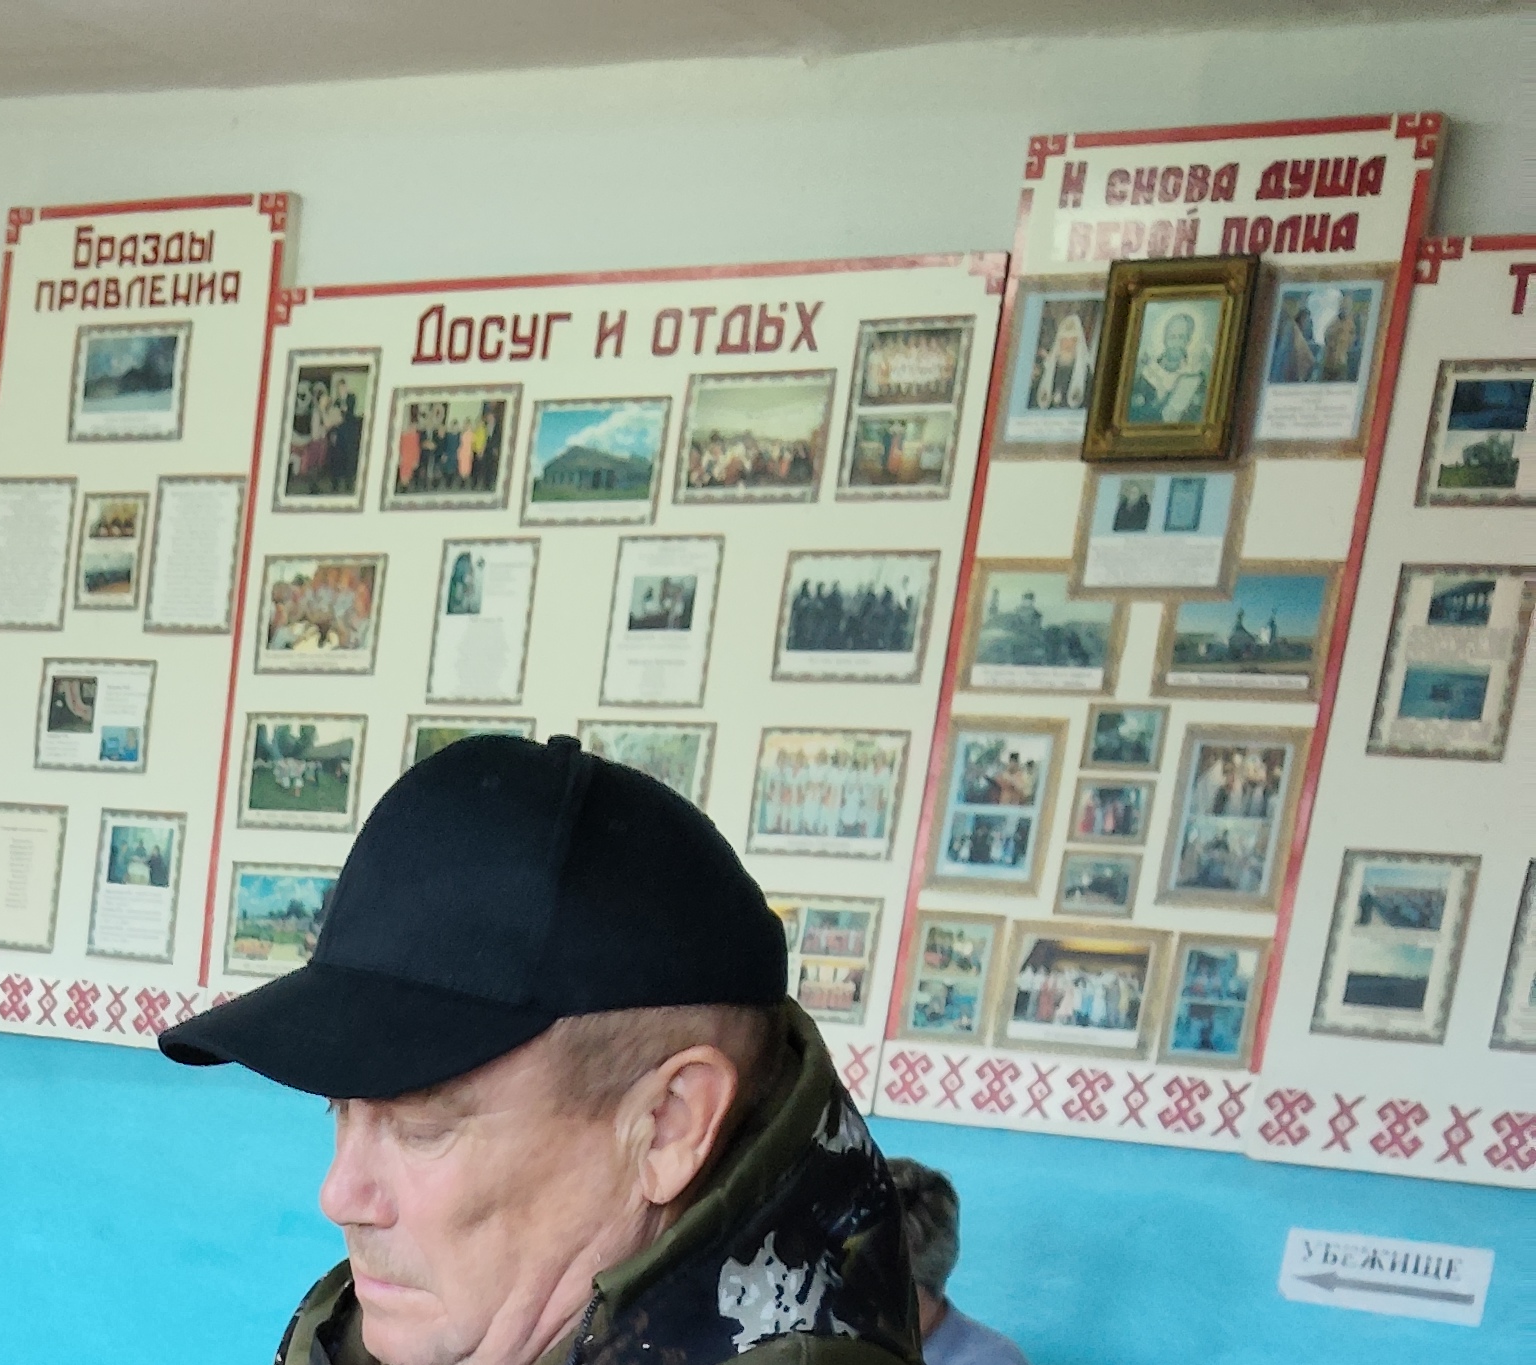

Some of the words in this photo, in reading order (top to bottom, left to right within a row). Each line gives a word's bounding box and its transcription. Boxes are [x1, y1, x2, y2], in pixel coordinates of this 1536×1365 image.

[1105, 163, 1239, 205] СНОВА
[1256, 154, 1387, 201] ДУША
[1219, 212, 1359, 255] ПОЛНА
[1302, 1240, 1463, 1281] УБЕЖИЩЕ
